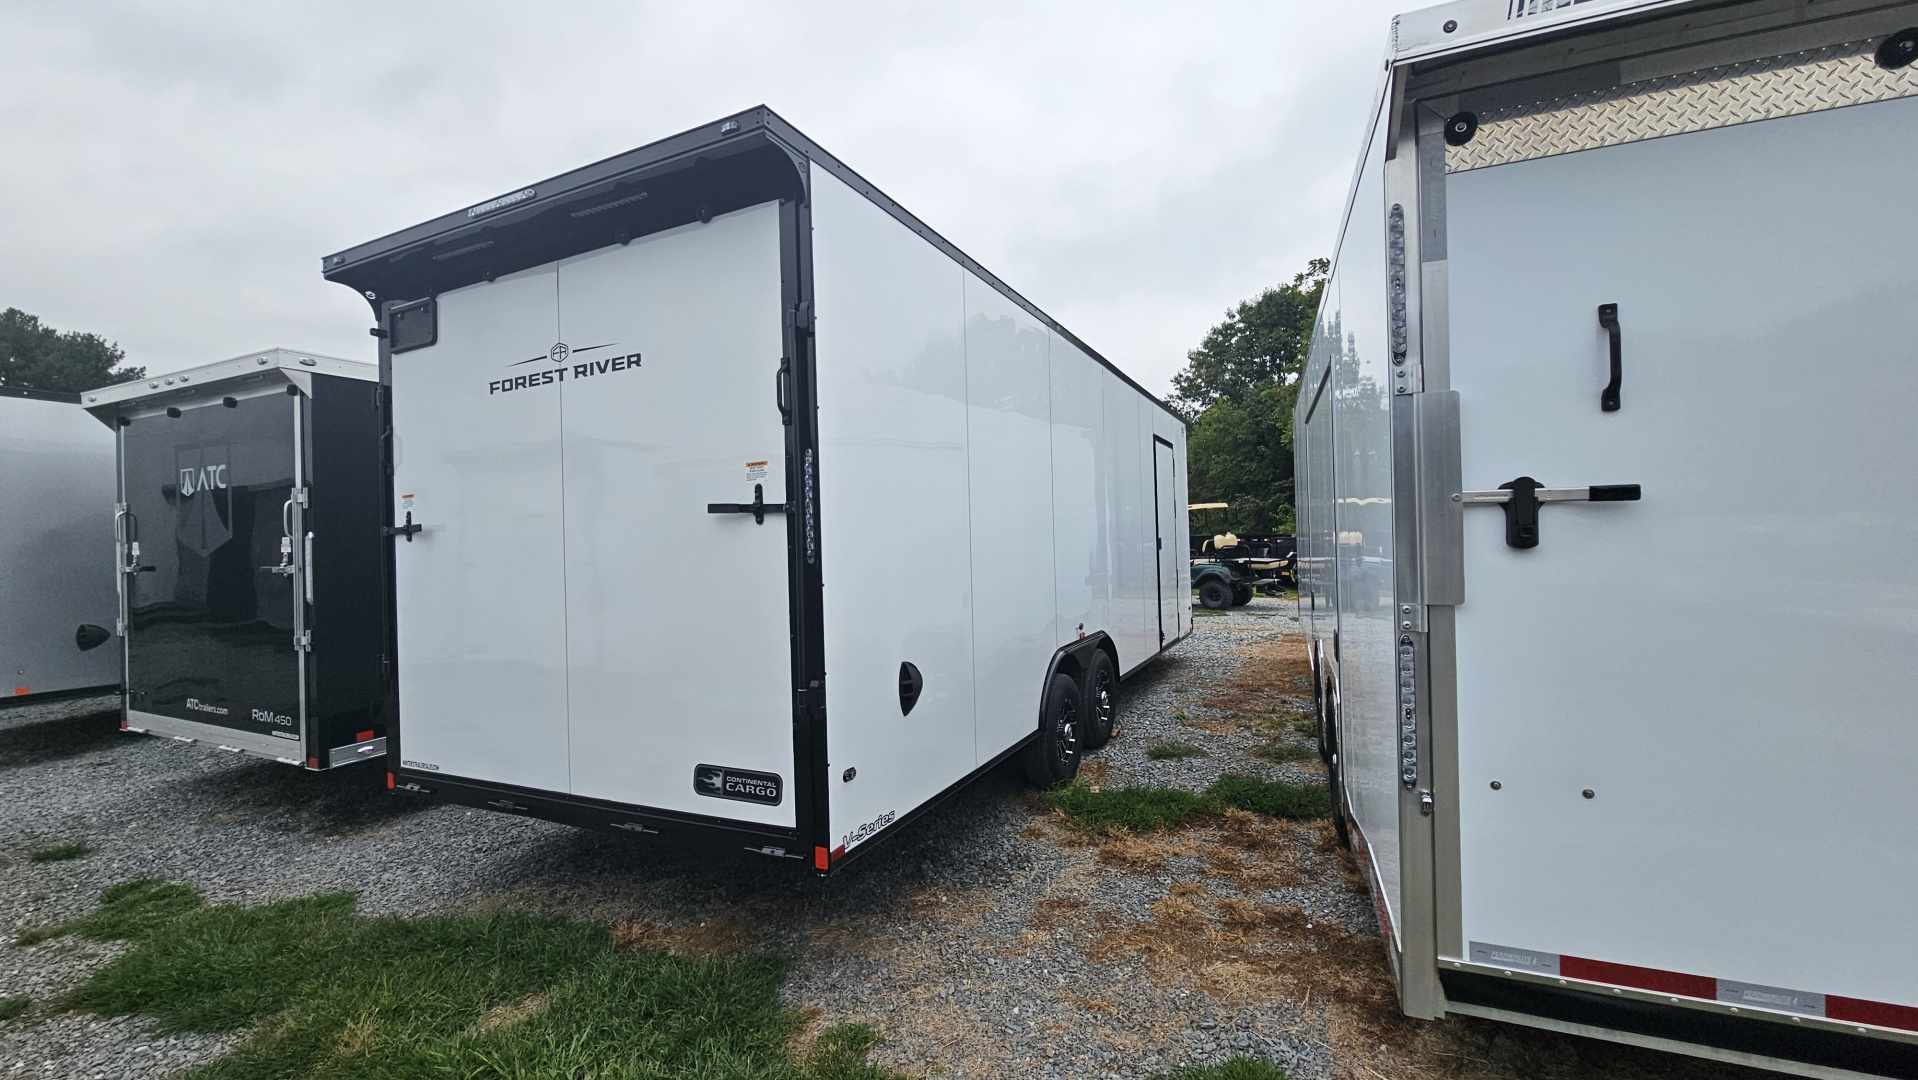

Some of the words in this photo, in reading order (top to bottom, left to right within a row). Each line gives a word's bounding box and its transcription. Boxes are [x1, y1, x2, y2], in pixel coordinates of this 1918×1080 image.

[489, 367, 568, 395] FOREST
[573, 353, 642, 379] RIVER
[197, 464, 226, 491] ATC
[186, 698, 229, 715] ATCtrailers.com
[252, 709, 273, 723] RoM
[274, 715, 292, 726] 450
[725, 782, 777, 797] CARGO
[726, 776, 777, 788] CONTINENTAL
[843, 810, 895, 849] V-Series
